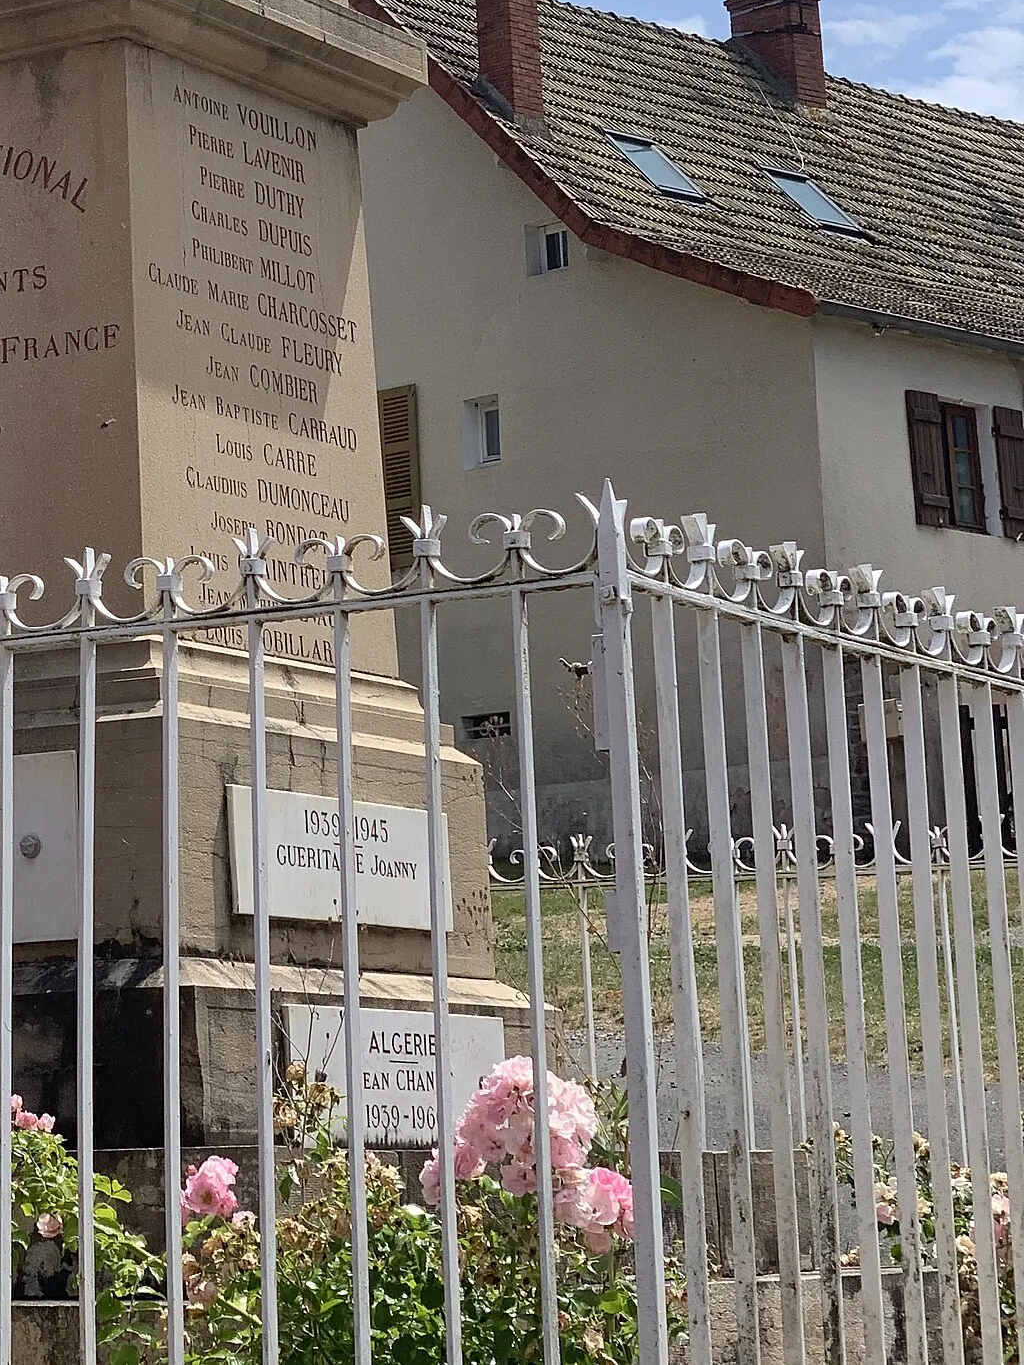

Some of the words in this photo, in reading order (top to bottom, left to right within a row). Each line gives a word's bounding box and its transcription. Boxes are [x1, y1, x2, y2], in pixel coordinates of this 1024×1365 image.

[173, 84, 229, 121] ANTOINE
[236, 103, 317, 152] VOUILLON
[188, 124, 234, 159] PIERRE
[243, 141, 306, 184] LAVENIR
[200, 166, 245, 199] PIERRE
[254, 181, 305, 219] DUTHY
[191, 200, 249, 236] CHARLES
[258, 219, 312, 257] DUPUIS
[192, 237, 254, 275] PHILIBERT
[260, 256, 316, 294] MILLOT
[148, 263, 199, 296] CLAUDE
[207, 280, 249, 311] MARIE
[257, 293, 357, 343] CHARCOSSET
[0, 324, 121, 365] FRANCE
[176, 309, 211, 336] JEAN
[221, 322, 271, 354] CLAUDE
[281, 336, 343, 376] FLEURY
[206, 356, 239, 382] JEAN
[250, 365, 318, 405] COMBIER
[172, 384, 206, 411] JEAN
[216, 398, 278, 431] BAPTISTE
[288, 413, 357, 451] CARRAUD
[216, 434, 253, 461] LOUIS
[263, 443, 317, 477] CARRE
[186, 466, 248, 498] CLAUDIUS
[258, 479, 349, 523] DUMONCEAU
[199, 584, 231, 606] JEAN
[262, 629, 334, 665] OBILLAR
[276, 844, 364, 874] GUERITAE
[371, 855, 417, 880] JOANNY
[369, 1031, 436, 1056] ALGERIE
